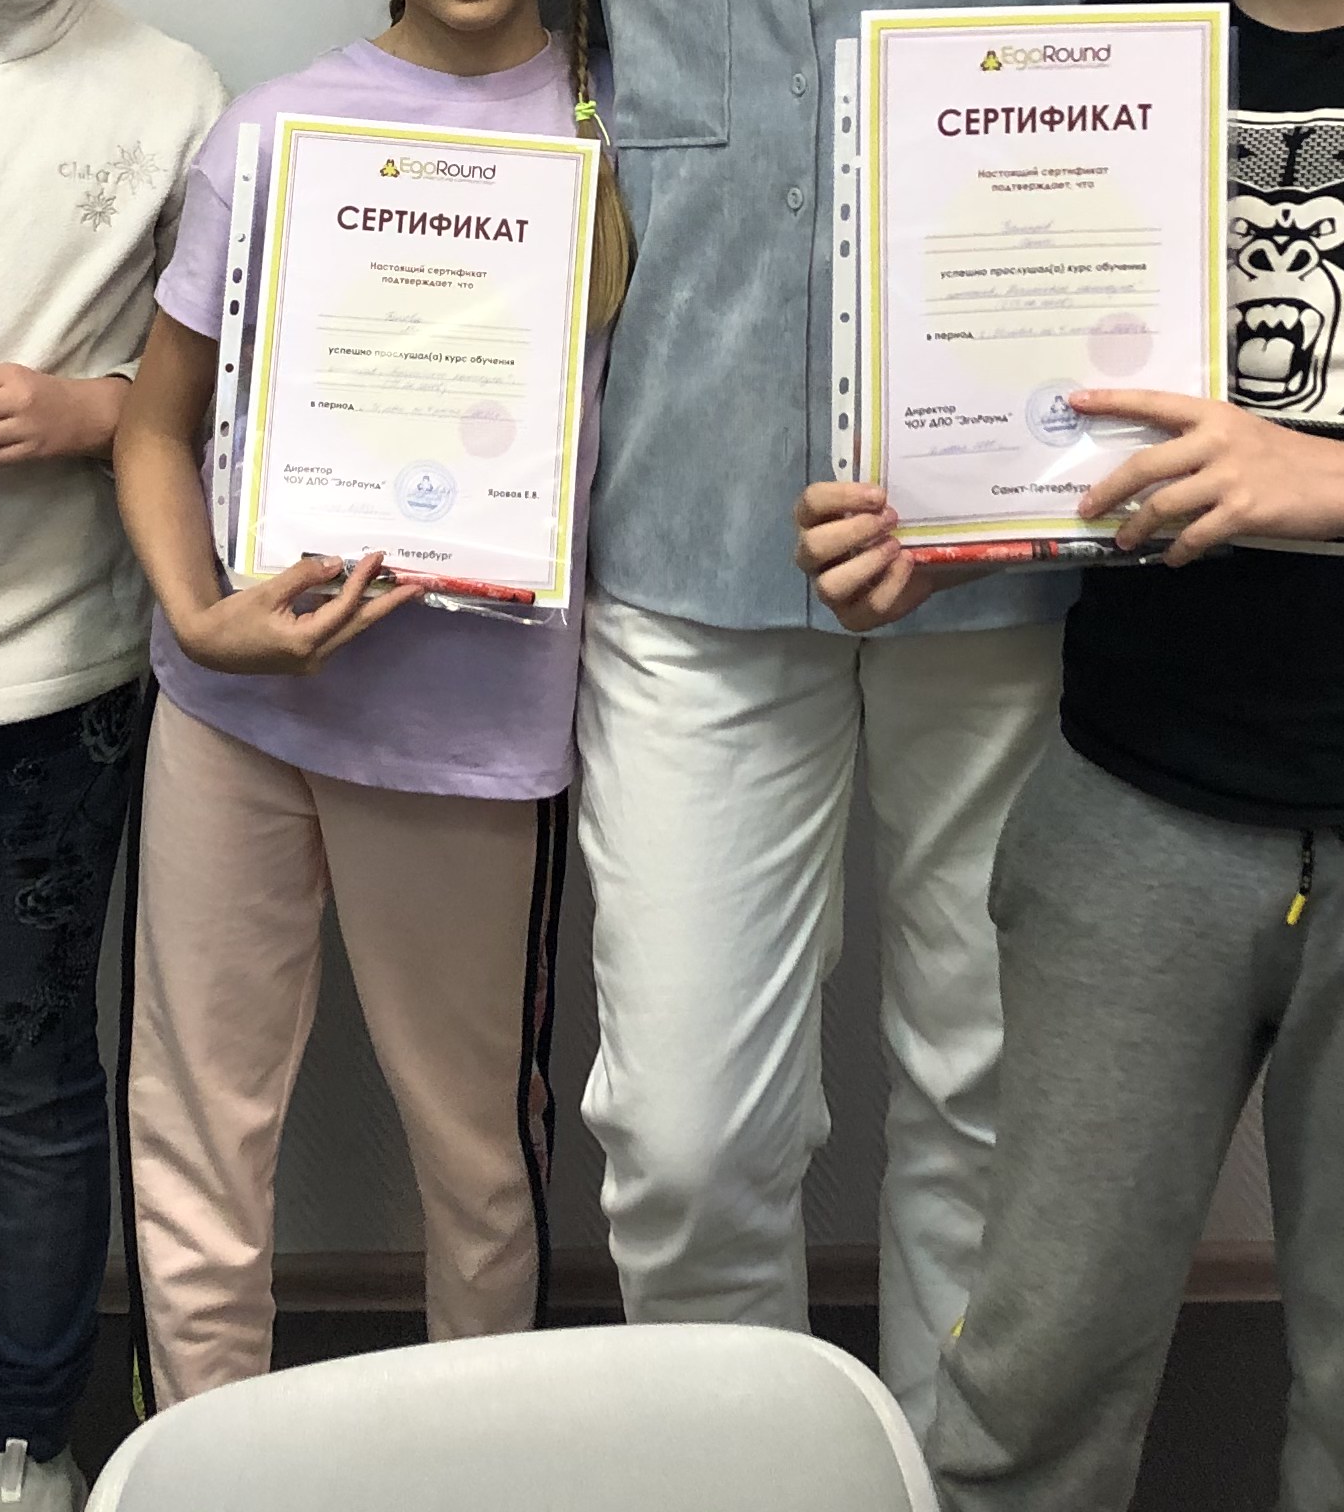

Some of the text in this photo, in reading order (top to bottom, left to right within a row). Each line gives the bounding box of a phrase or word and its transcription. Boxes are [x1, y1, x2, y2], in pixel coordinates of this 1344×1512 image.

[1000, 44, 1112, 70] EgoRound
[937, 103, 1153, 137] СЕРТИФИКАТ
[399, 156, 496, 180] EgoRound
[337, 205, 529, 243] СЕРТИФИКАТ
